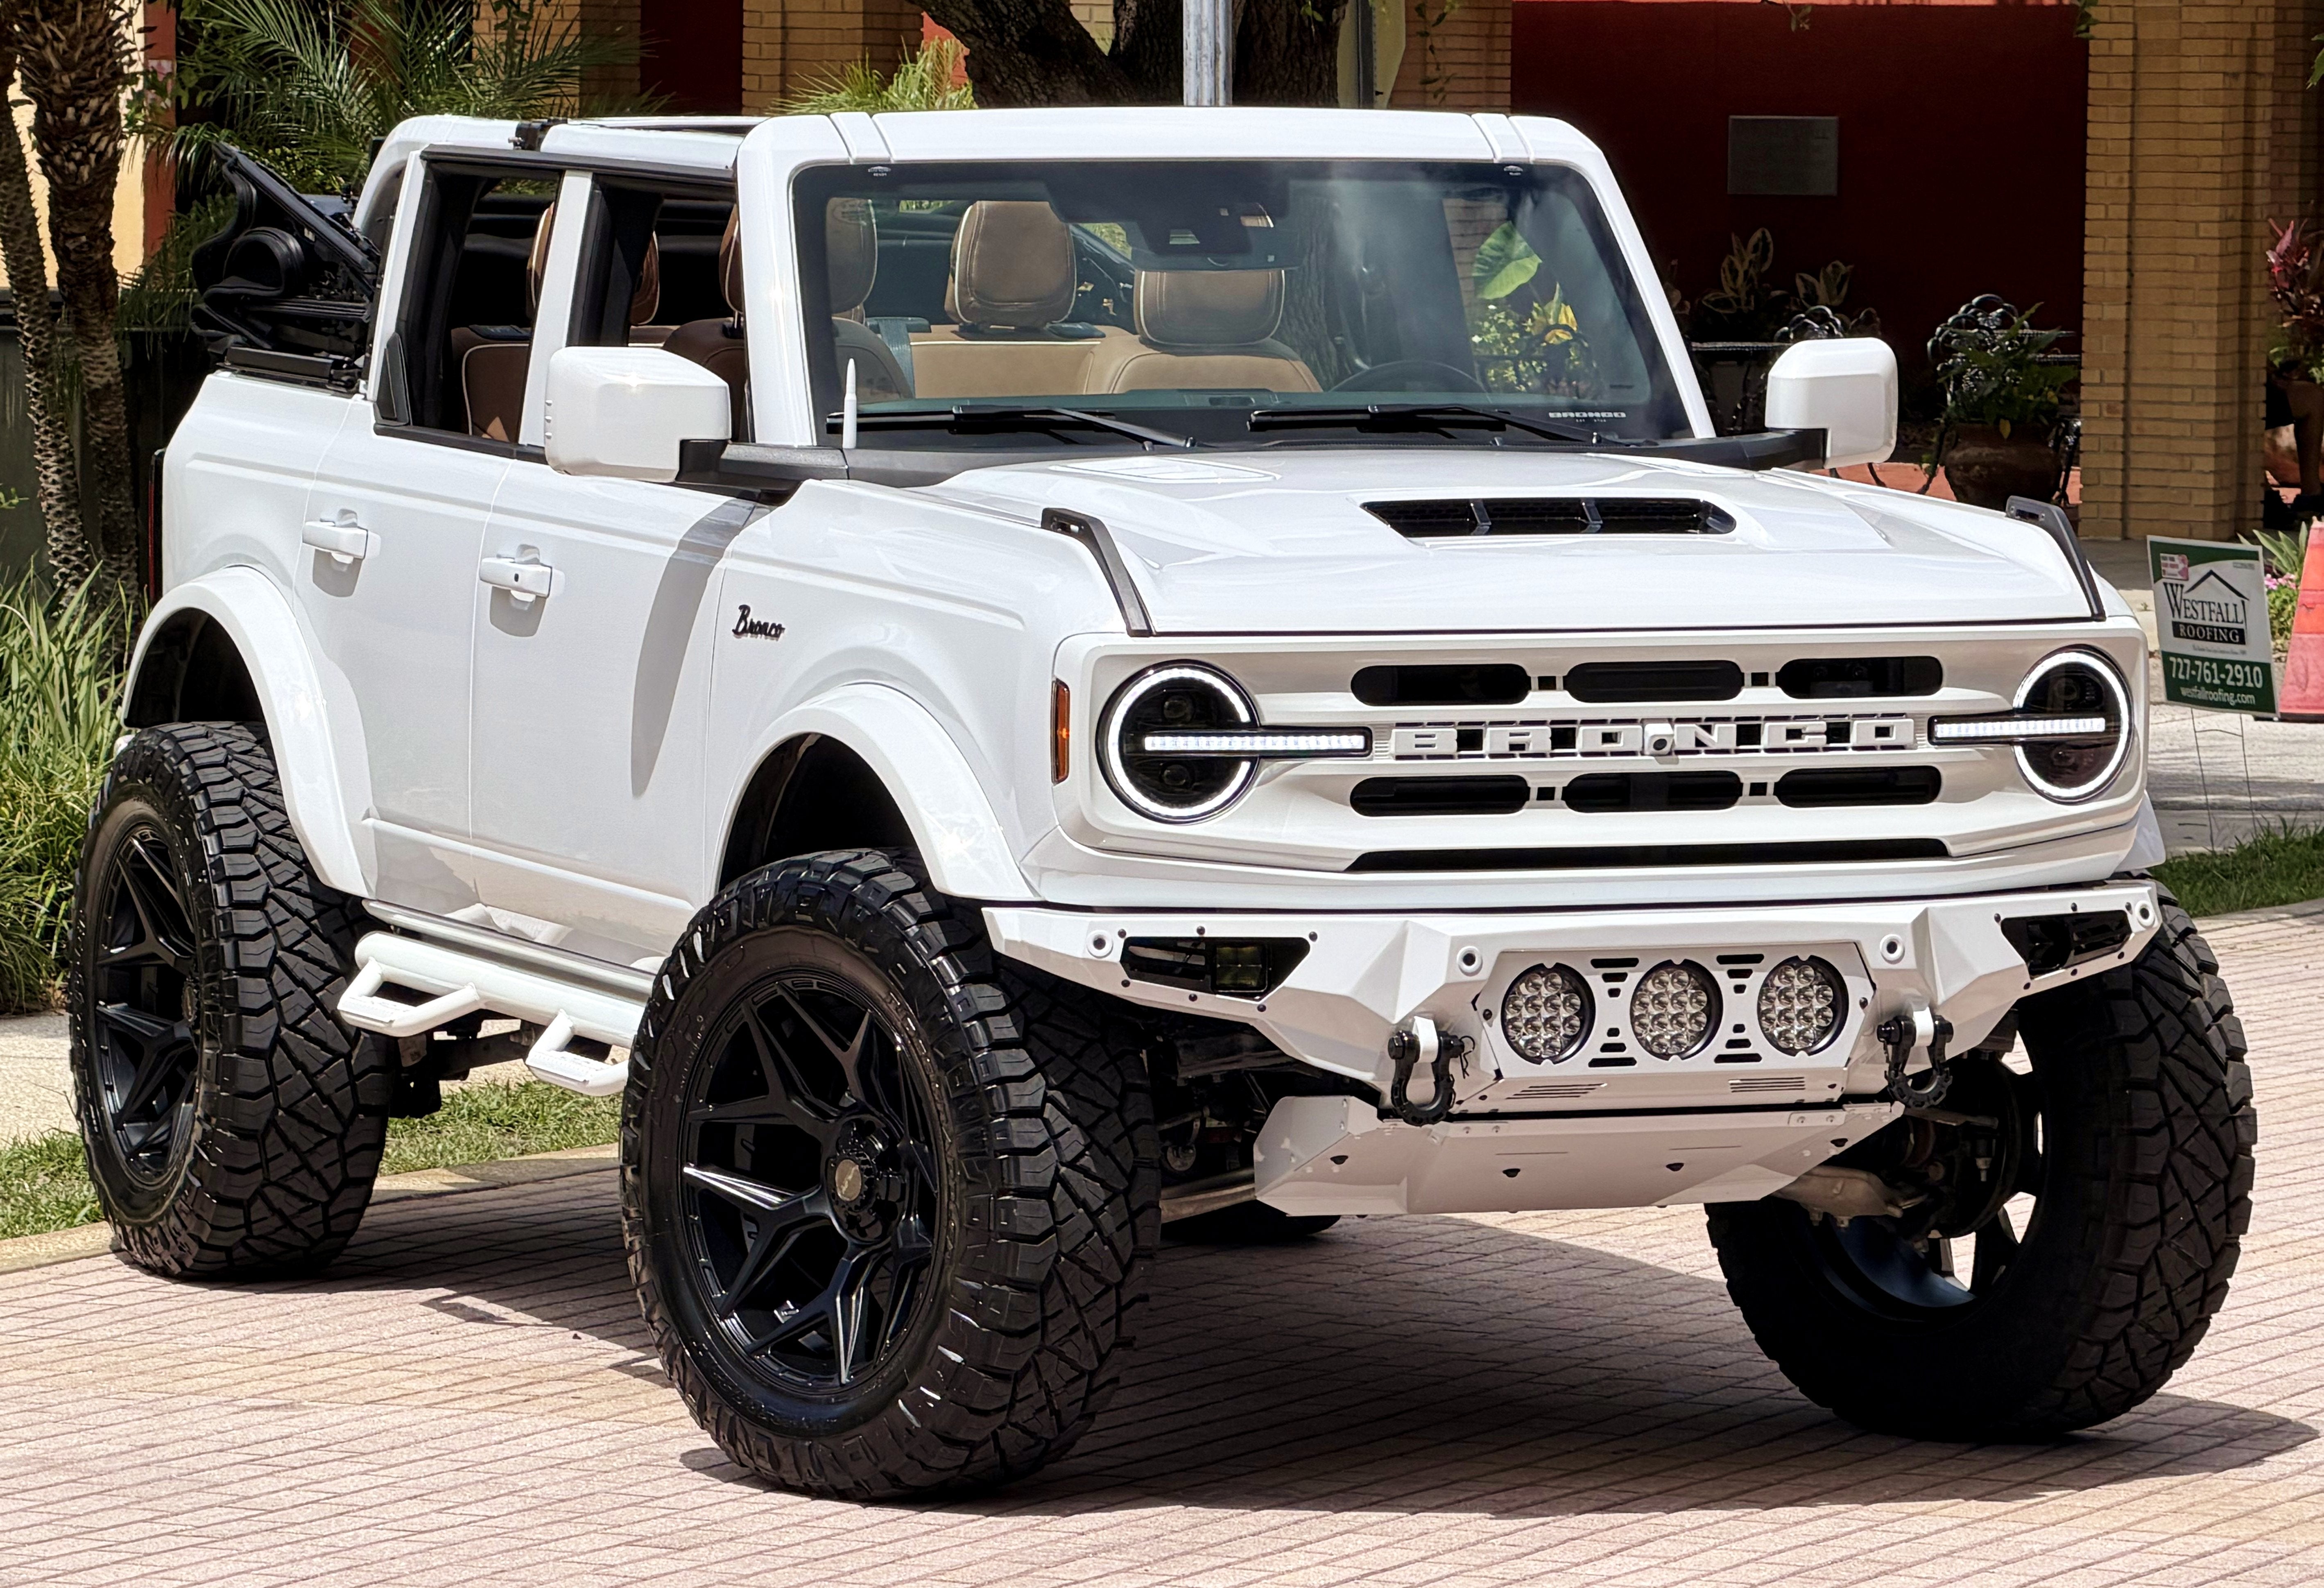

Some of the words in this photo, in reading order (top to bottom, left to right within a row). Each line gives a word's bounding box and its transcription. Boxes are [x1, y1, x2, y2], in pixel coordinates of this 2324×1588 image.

[2163, 582, 2243, 624] WESTFALL
[732, 604, 785, 638] Bronco
[2179, 624, 2239, 642] ROOFING
[2169, 657, 2263, 688] 727-761-2910
[2180, 685, 2256, 706] wroofing.com
[1391, 718, 1914, 754] BRONCO
